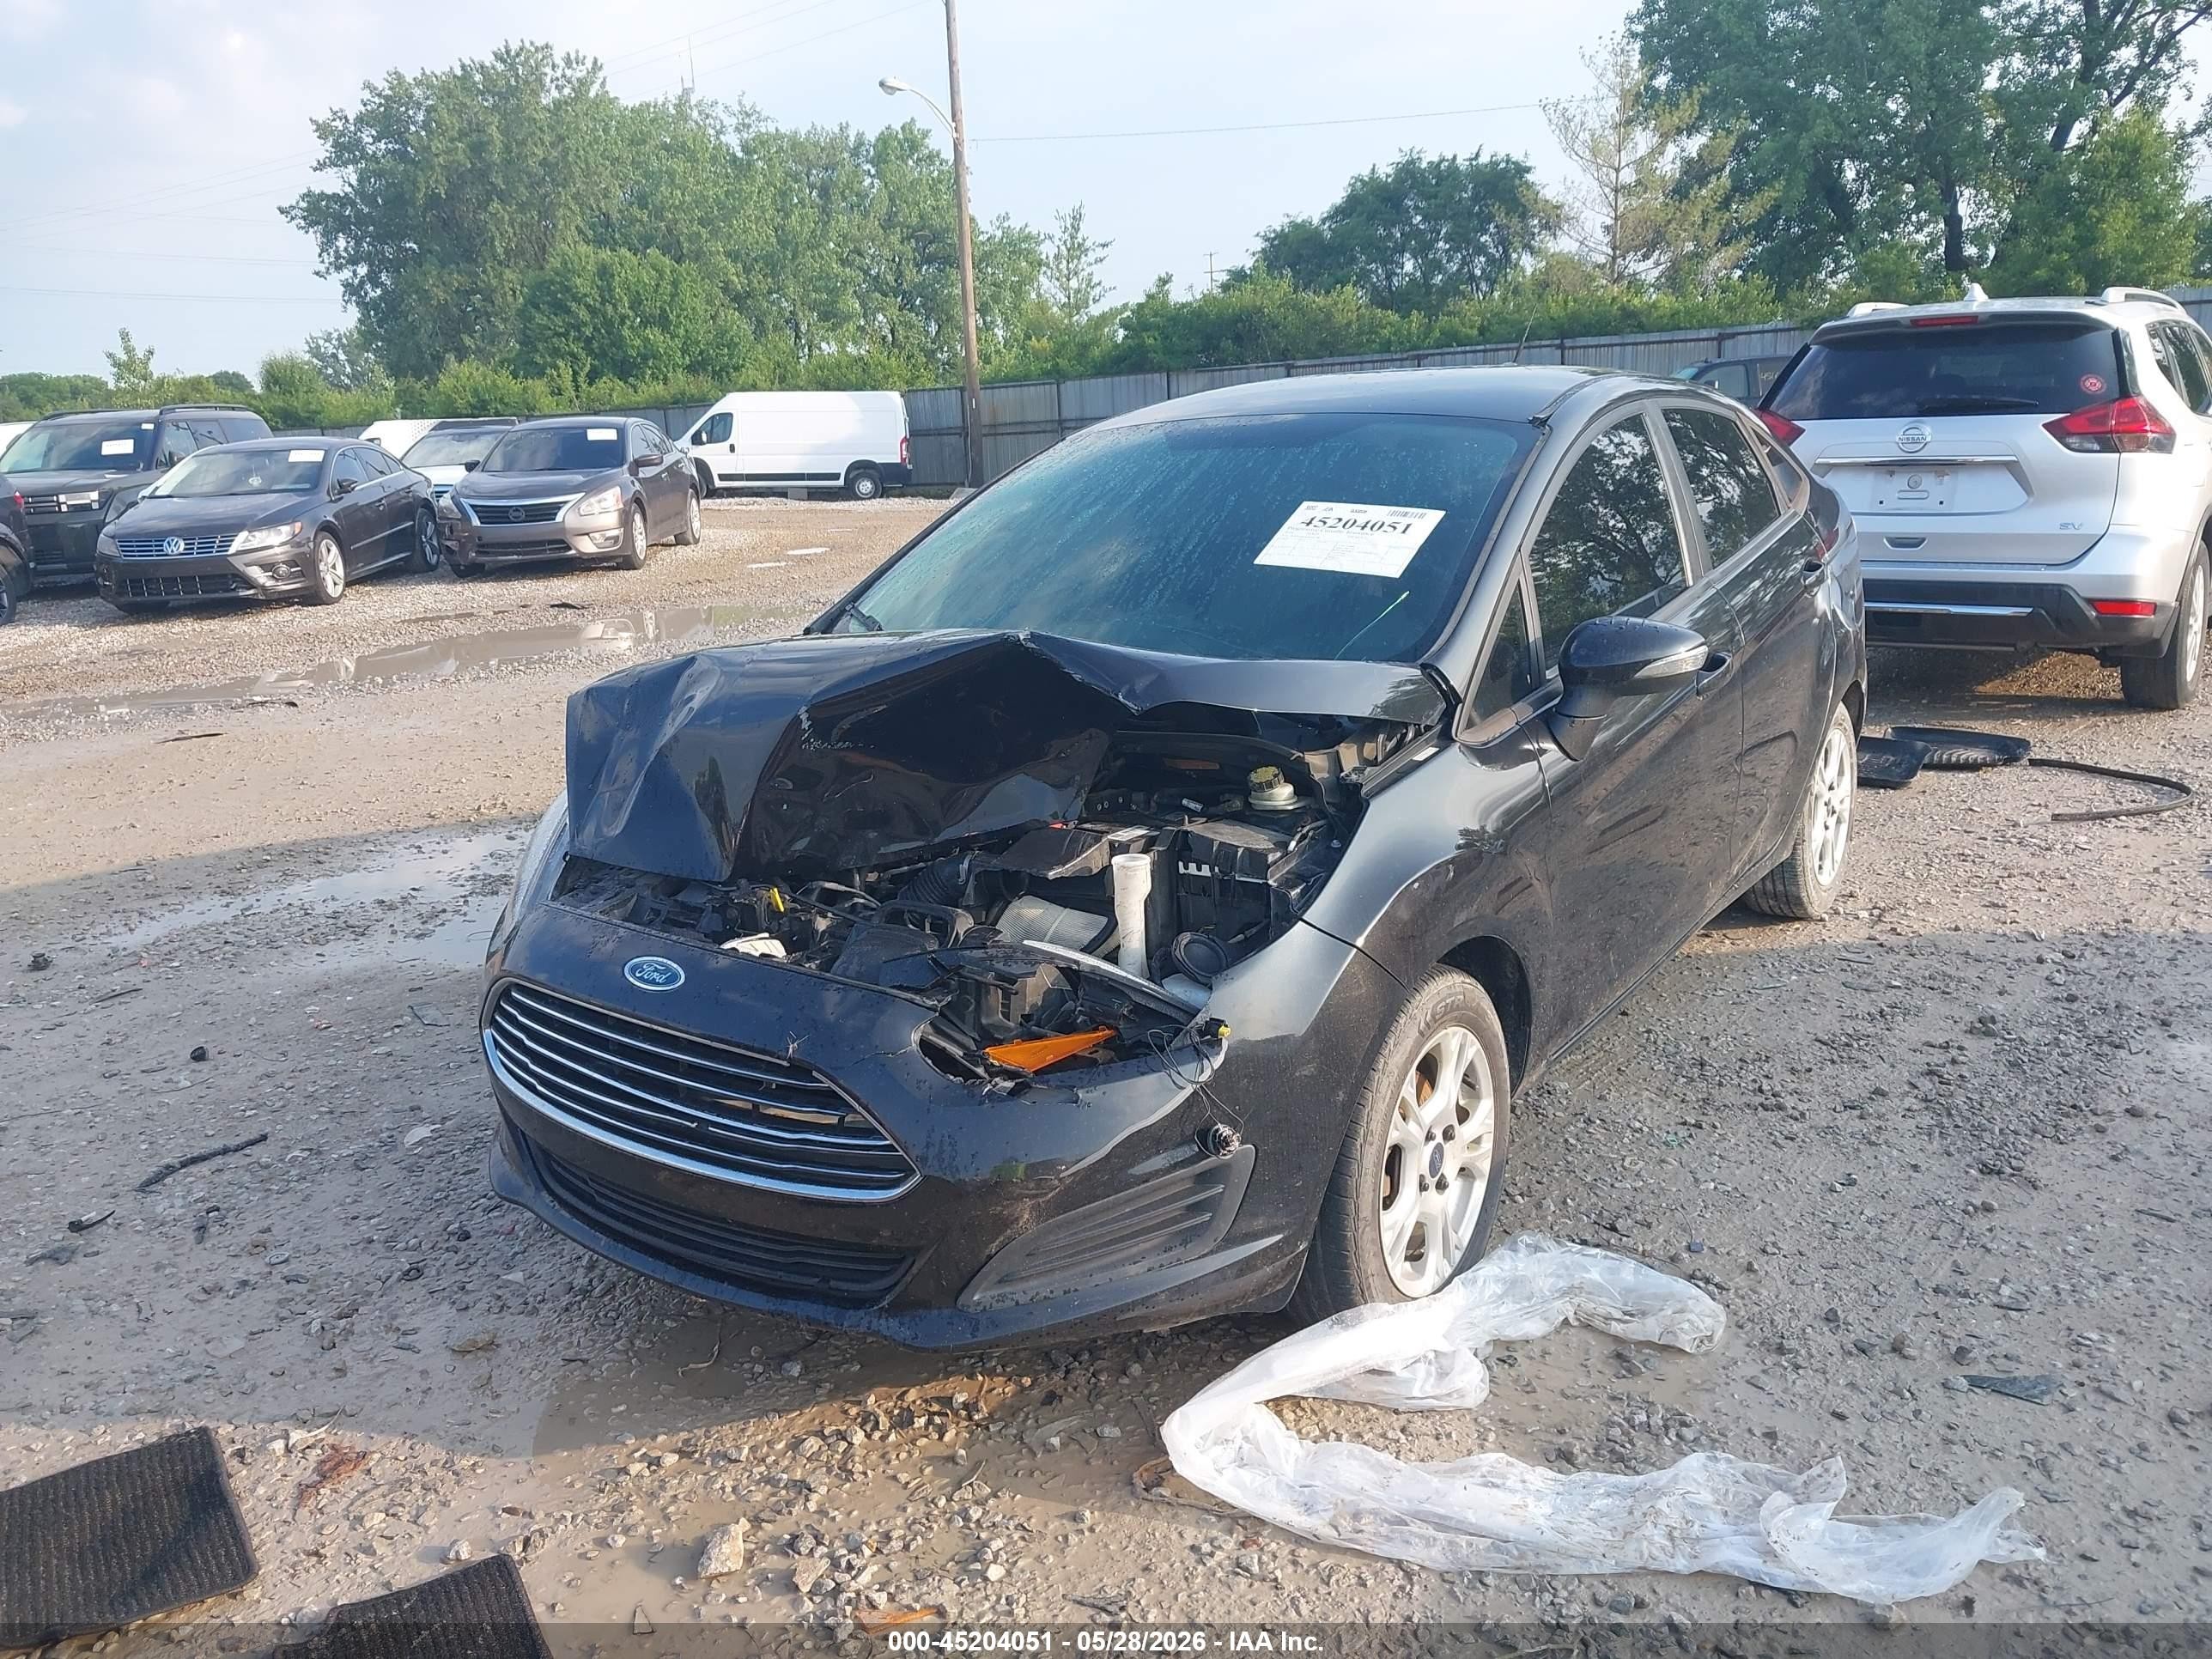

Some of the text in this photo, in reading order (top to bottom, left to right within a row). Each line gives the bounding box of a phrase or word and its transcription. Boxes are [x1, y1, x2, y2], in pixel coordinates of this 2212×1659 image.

[1300, 516, 1413, 534] 45204051
[2059, 522, 2083, 531] SV
[635, 962, 672, 984] Ford
